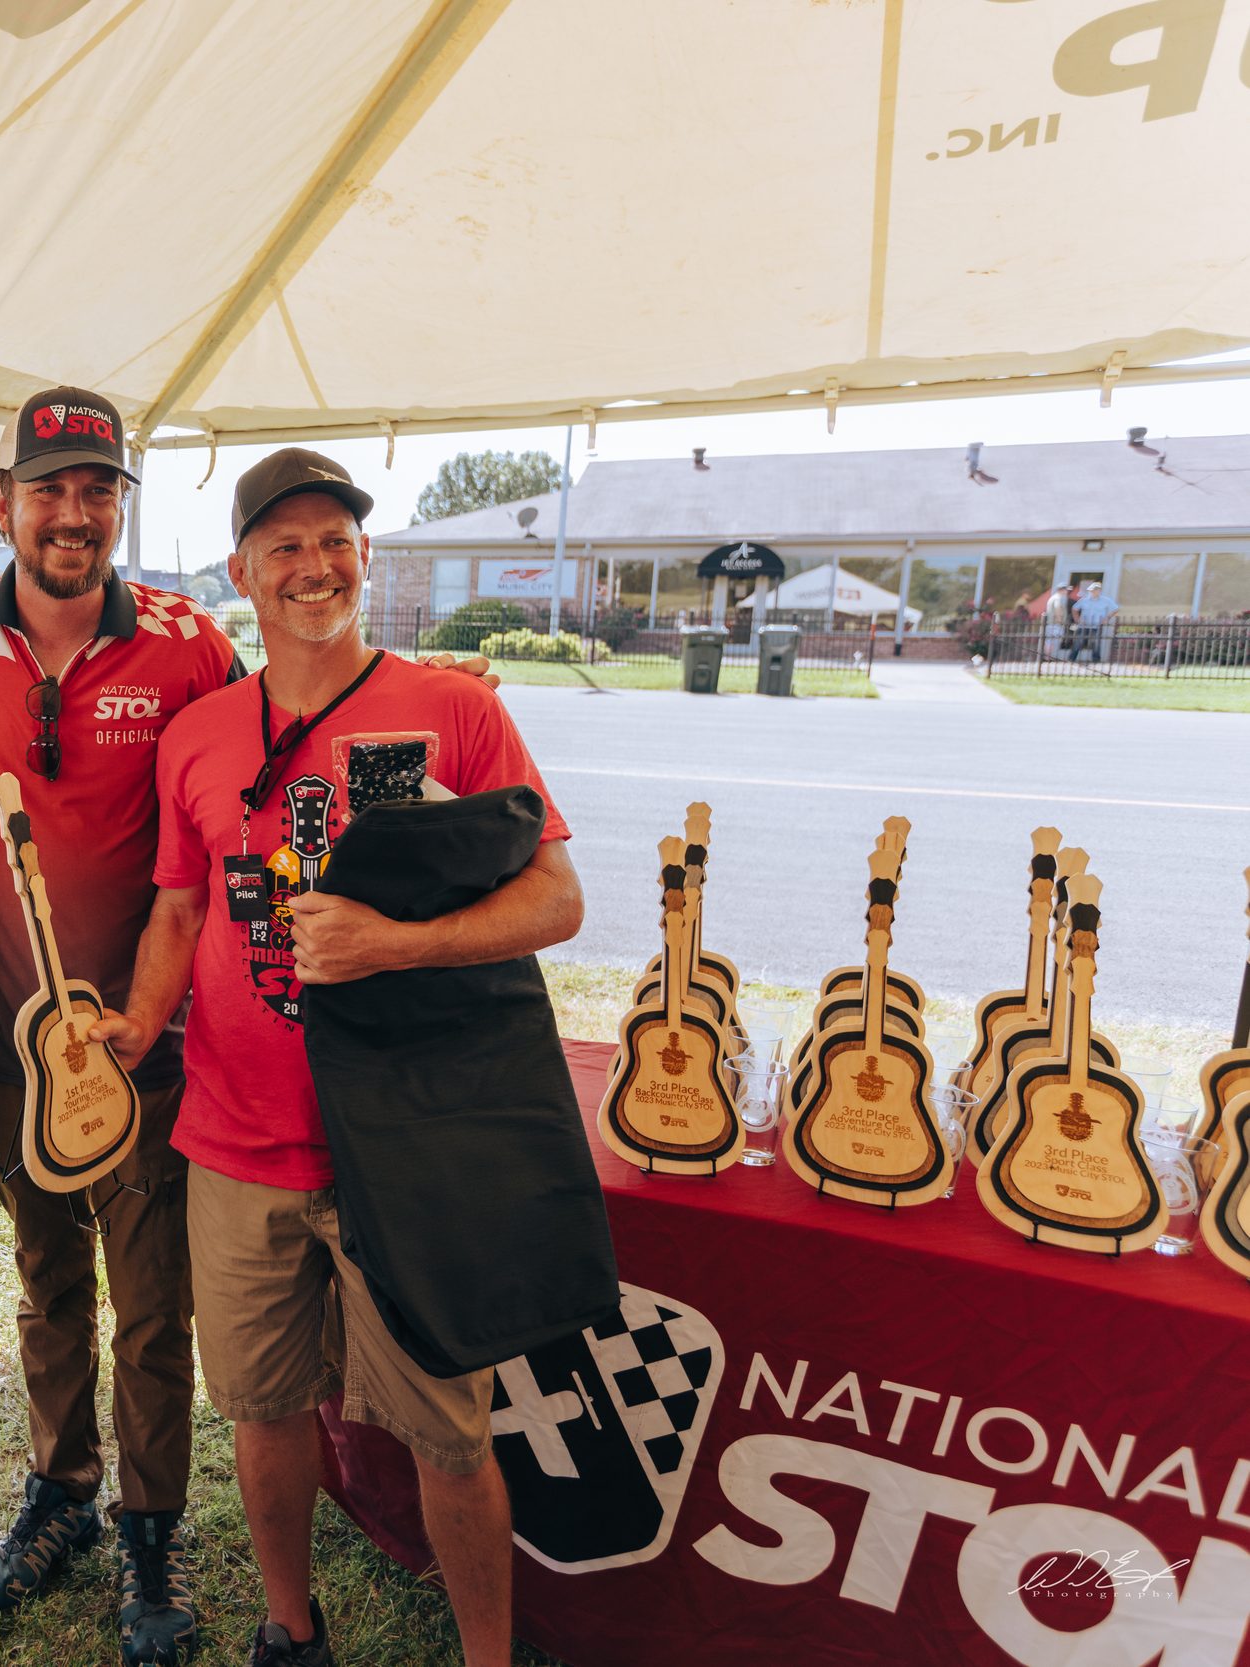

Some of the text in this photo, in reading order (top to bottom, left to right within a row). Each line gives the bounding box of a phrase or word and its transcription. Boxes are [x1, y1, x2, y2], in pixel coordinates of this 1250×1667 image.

[68, 406, 112, 424] NATIONAL
[65, 415, 116, 444] STOL
[100, 686, 162, 696] NATIONAL
[94, 696, 162, 720] STOL
[96, 728, 156, 744] OFFICIAL
[241, 877, 264, 886] STOL
[236, 890, 258, 899] Pilot
[251, 920, 268, 930] SEPT
[252, 930, 266, 942] 1-2
[66, 1075, 102, 1100] 1st Place
[635, 1088, 714, 1104] Backcountry Class
[650, 1081, 699, 1095] 3rd Place
[58, 1086, 118, 1123] 2023 Music City STOL
[64, 1083, 108, 1110] Touring Class
[830, 1114, 911, 1132] Adventure Class
[842, 1106, 899, 1123] 3rd Place
[824, 1121, 916, 1140] 2023 Music City STOL
[864, 1149, 885, 1157] STOL
[1044, 1144, 1109, 1165] 3rd Place
[1025, 1160, 1126, 1184] 2023 Music City STOL
[1045, 1155, 1107, 1173] Sport Class
[1069, 1192, 1093, 1201] STOL
